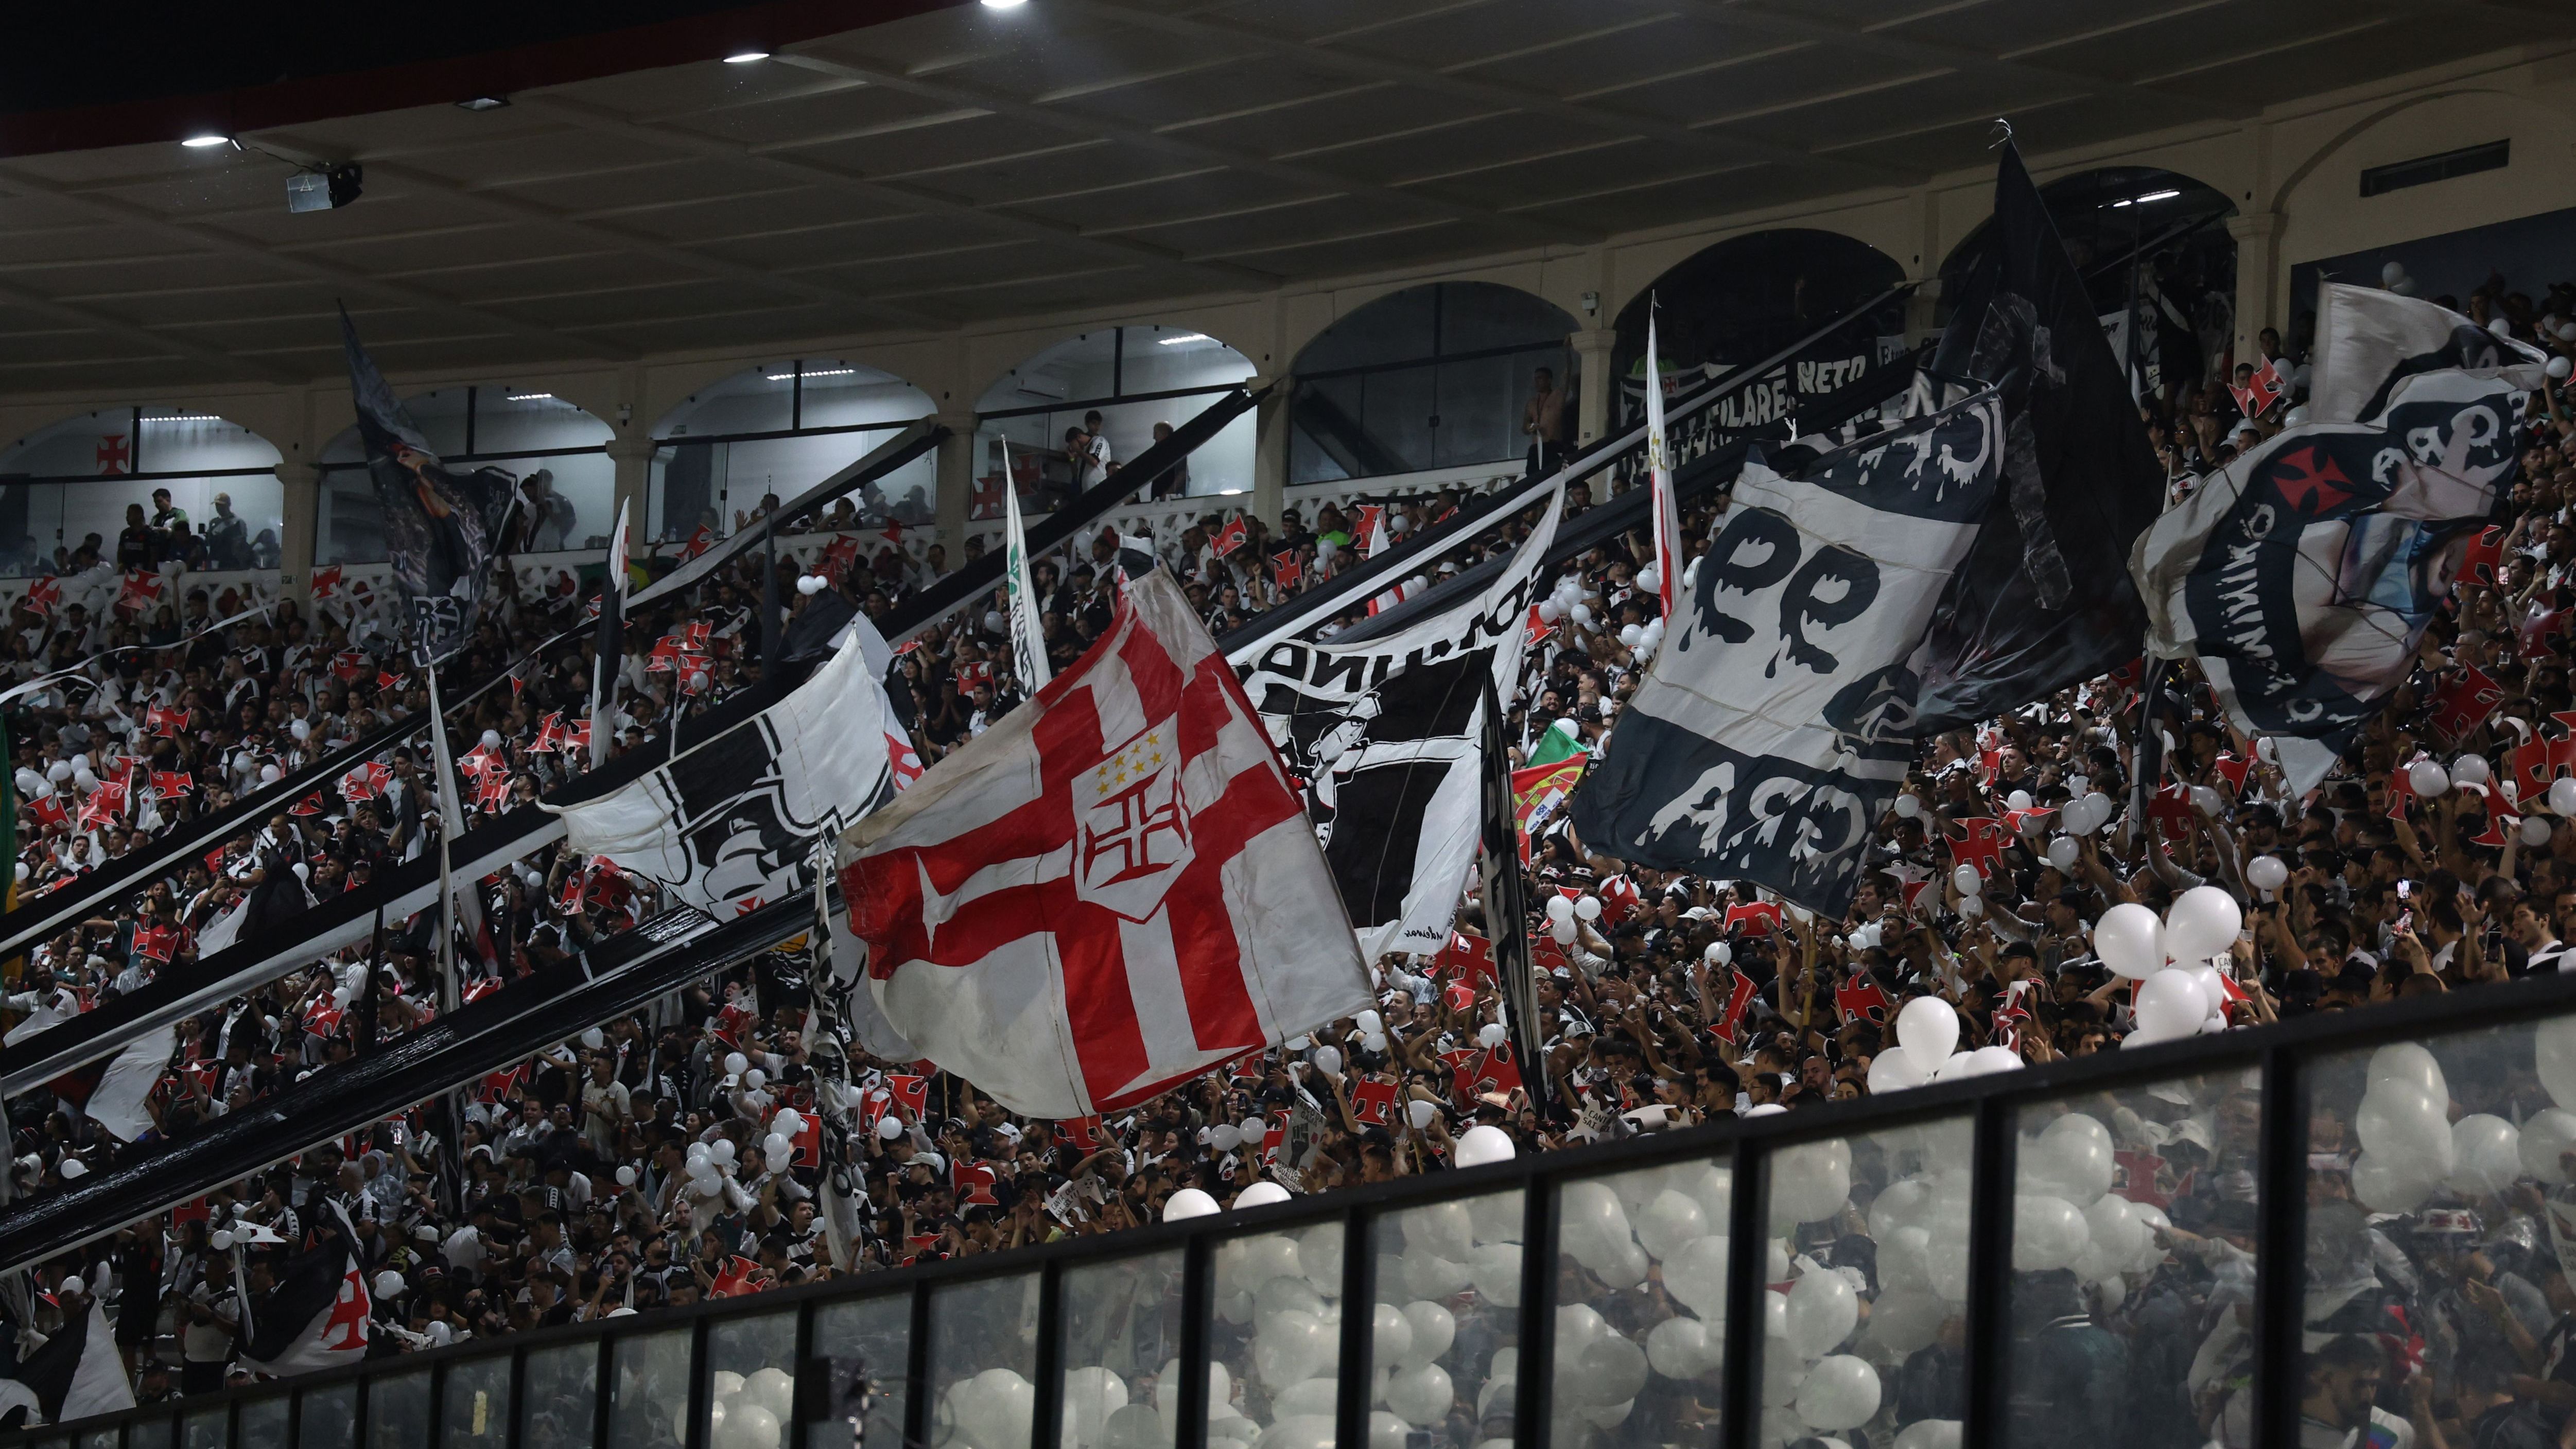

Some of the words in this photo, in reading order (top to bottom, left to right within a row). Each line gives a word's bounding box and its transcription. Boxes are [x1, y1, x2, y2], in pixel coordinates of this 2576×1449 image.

[1710, 378, 1788, 428] ILARE
[2218, 957, 2233, 966] CAN
[1295, 1098, 1314, 1116] VASCO
[1316, 1115, 1323, 1124] DA
[1300, 1111, 1317, 1127] GAMA
[1582, 1117, 1597, 1129] SAI
[1276, 1165, 1300, 1187] IGUALDAD
[1051, 1194, 1065, 1210] CANTA
[1065, 1184, 1076, 1196] QUE
[1056, 1207, 1065, 1218] SAI
